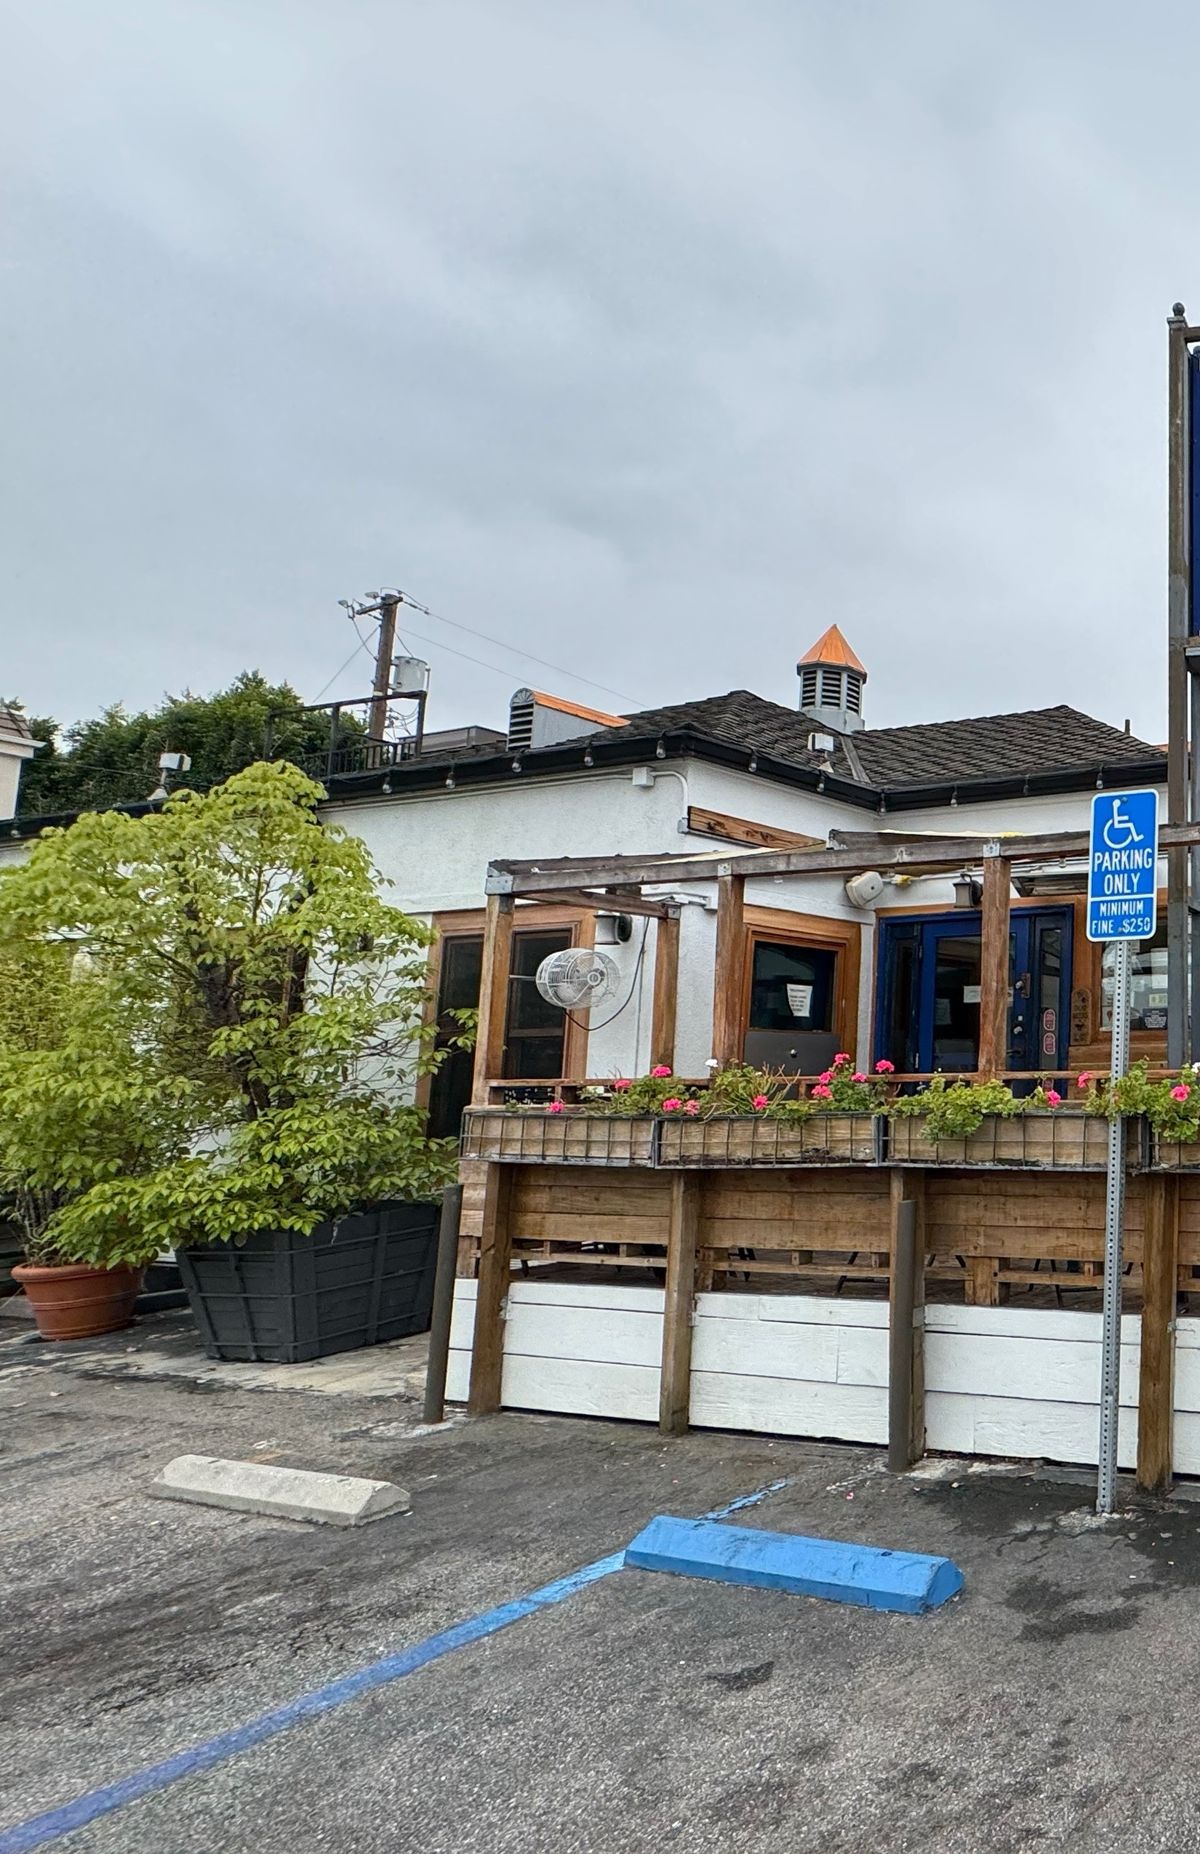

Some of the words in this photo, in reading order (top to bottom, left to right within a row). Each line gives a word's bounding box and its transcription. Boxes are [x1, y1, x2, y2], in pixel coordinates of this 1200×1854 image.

[1094, 848, 1153, 873] PARKING
[1104, 873, 1141, 895] ONLY
[1100, 900, 1144, 917] MINIMUM
[1092, 919, 1115, 935] FINE
[1122, 917, 1151, 934] $250
